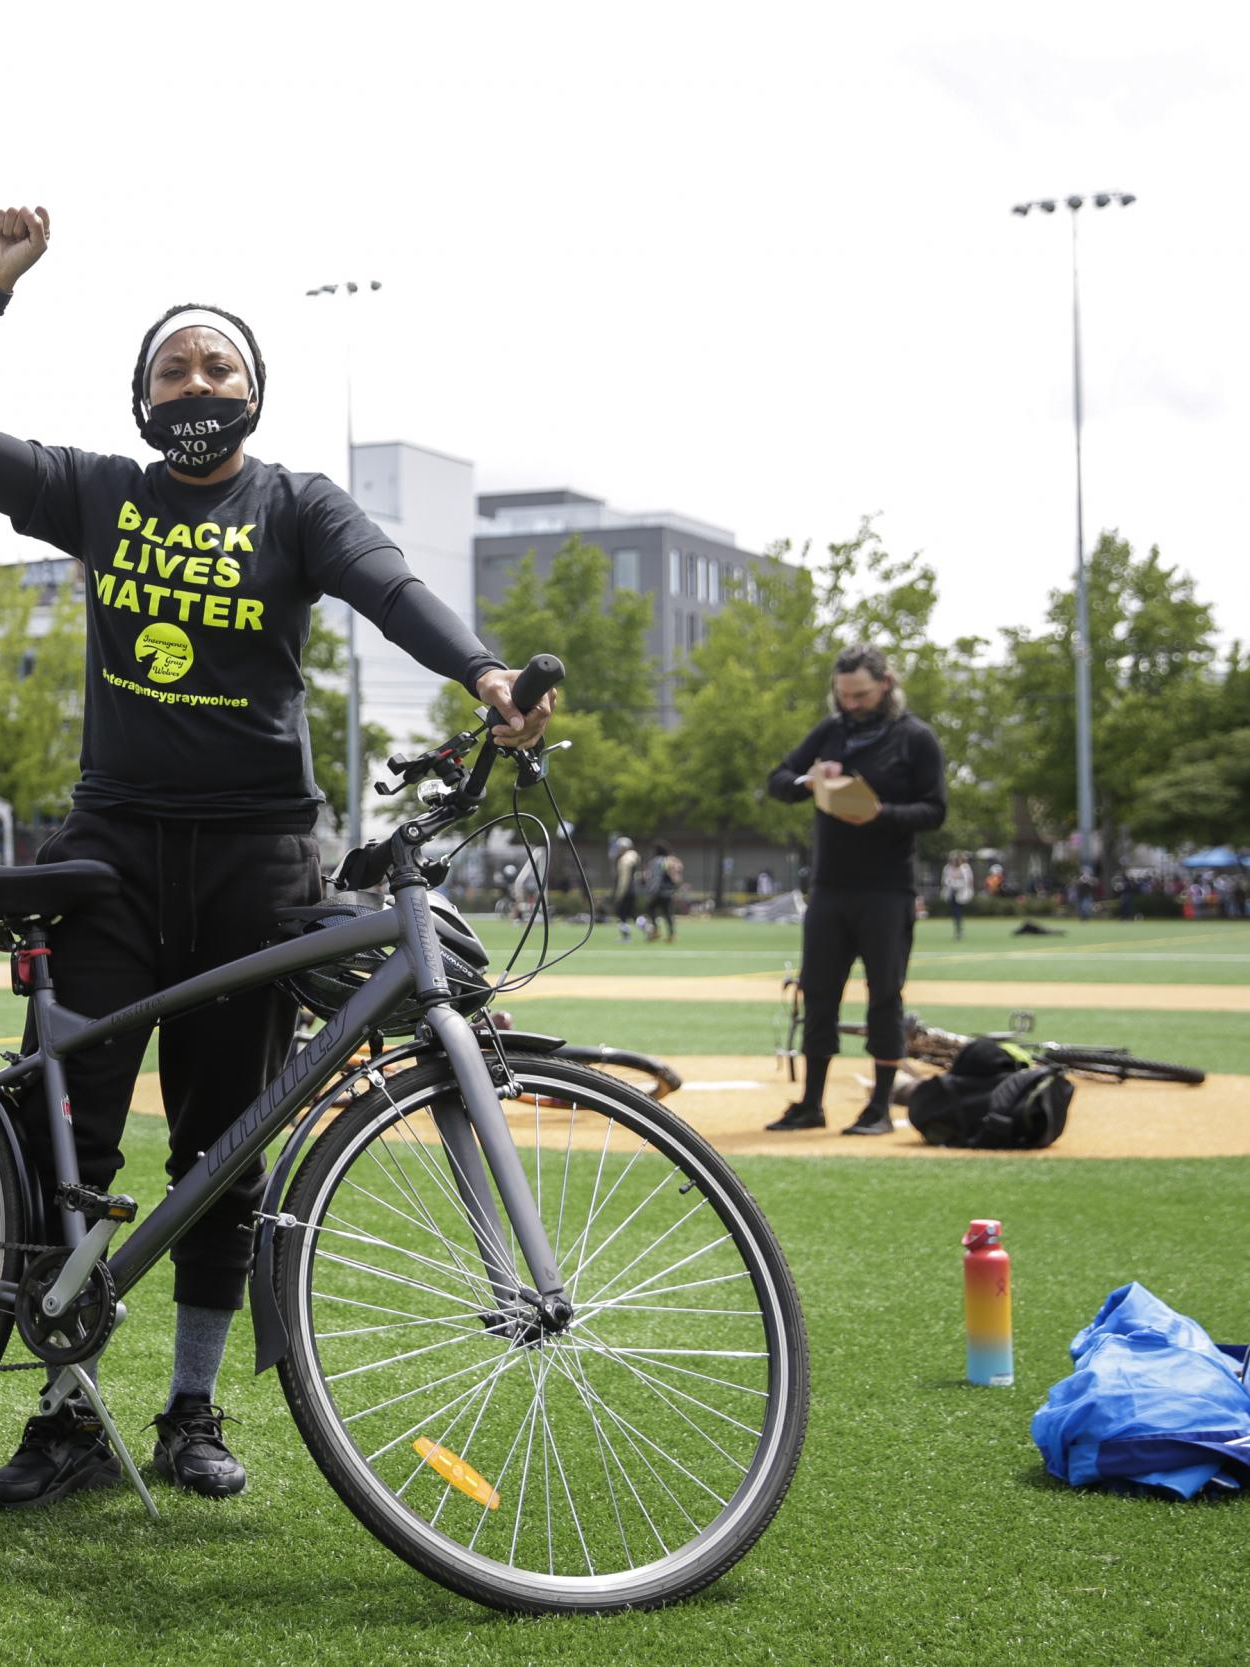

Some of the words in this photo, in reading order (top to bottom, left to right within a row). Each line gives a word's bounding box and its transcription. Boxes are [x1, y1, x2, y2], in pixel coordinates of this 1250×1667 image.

[170, 420, 221, 436] WASH
[180, 440, 207, 453] YO
[117, 500, 257, 552] BLACK
[112, 539, 241, 588] LIVES
[94, 570, 265, 631] MATTER
[440, 951, 474, 978] SCHWIN
